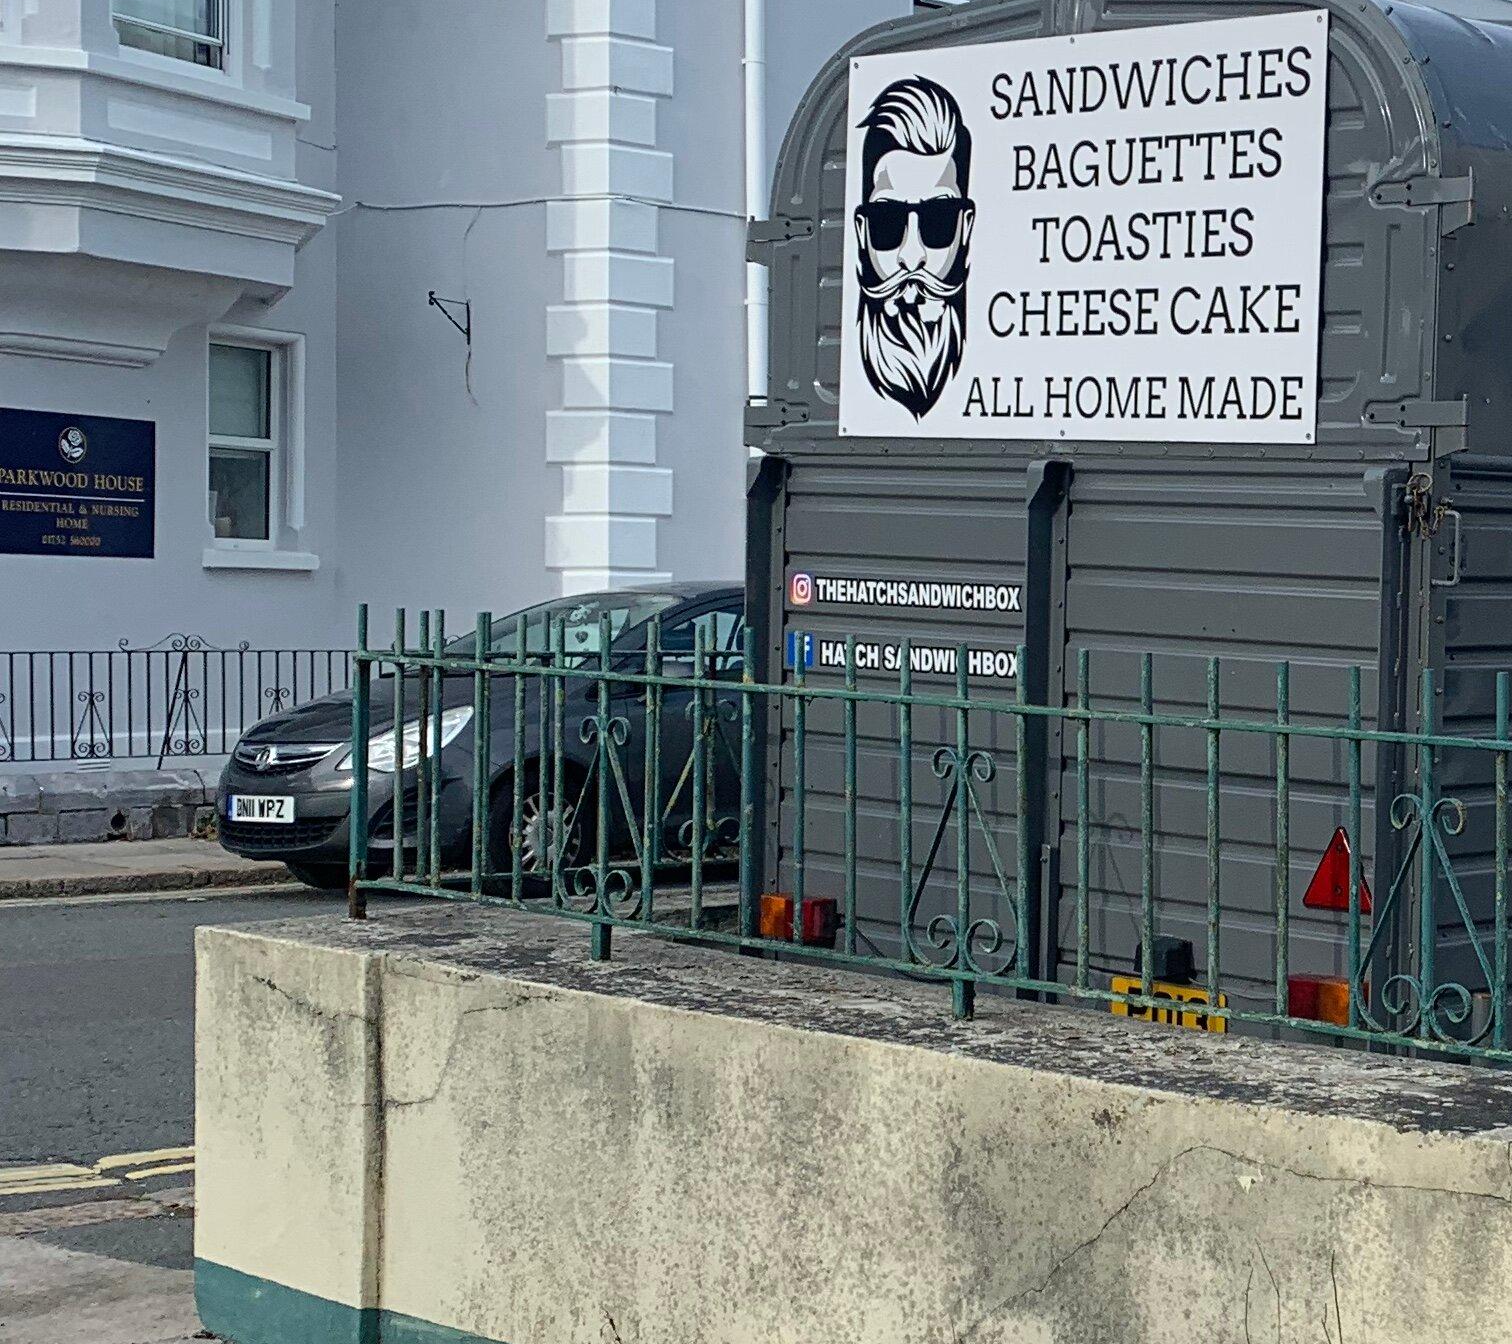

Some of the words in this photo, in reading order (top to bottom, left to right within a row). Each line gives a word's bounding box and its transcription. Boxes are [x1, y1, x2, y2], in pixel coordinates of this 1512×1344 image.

[991, 46, 1311, 119] SANDWICHES
[1013, 128, 1282, 190] BAGUETTES
[1032, 208, 1253, 262] TOASTIES
[989, 289, 1158, 337] CHEESE
[1171, 285, 1300, 335] CAKE
[963, 377, 1033, 417] ALL
[1044, 377, 1166, 418] HOME
[1178, 377, 1302, 419] MADE
[0, 468, 87, 488] PARKWOOD
[95, 475, 144, 491] HOUSE
[2, 500, 74, 514] RESIDENTIAL
[92, 505, 139, 517] NURSING
[56, 518, 88, 529] HOME
[816, 578, 1021, 611] THEHATCHSANDWICHBOX
[820, 641, 879, 669] HACH
[258, 799, 284, 818] WPZ
